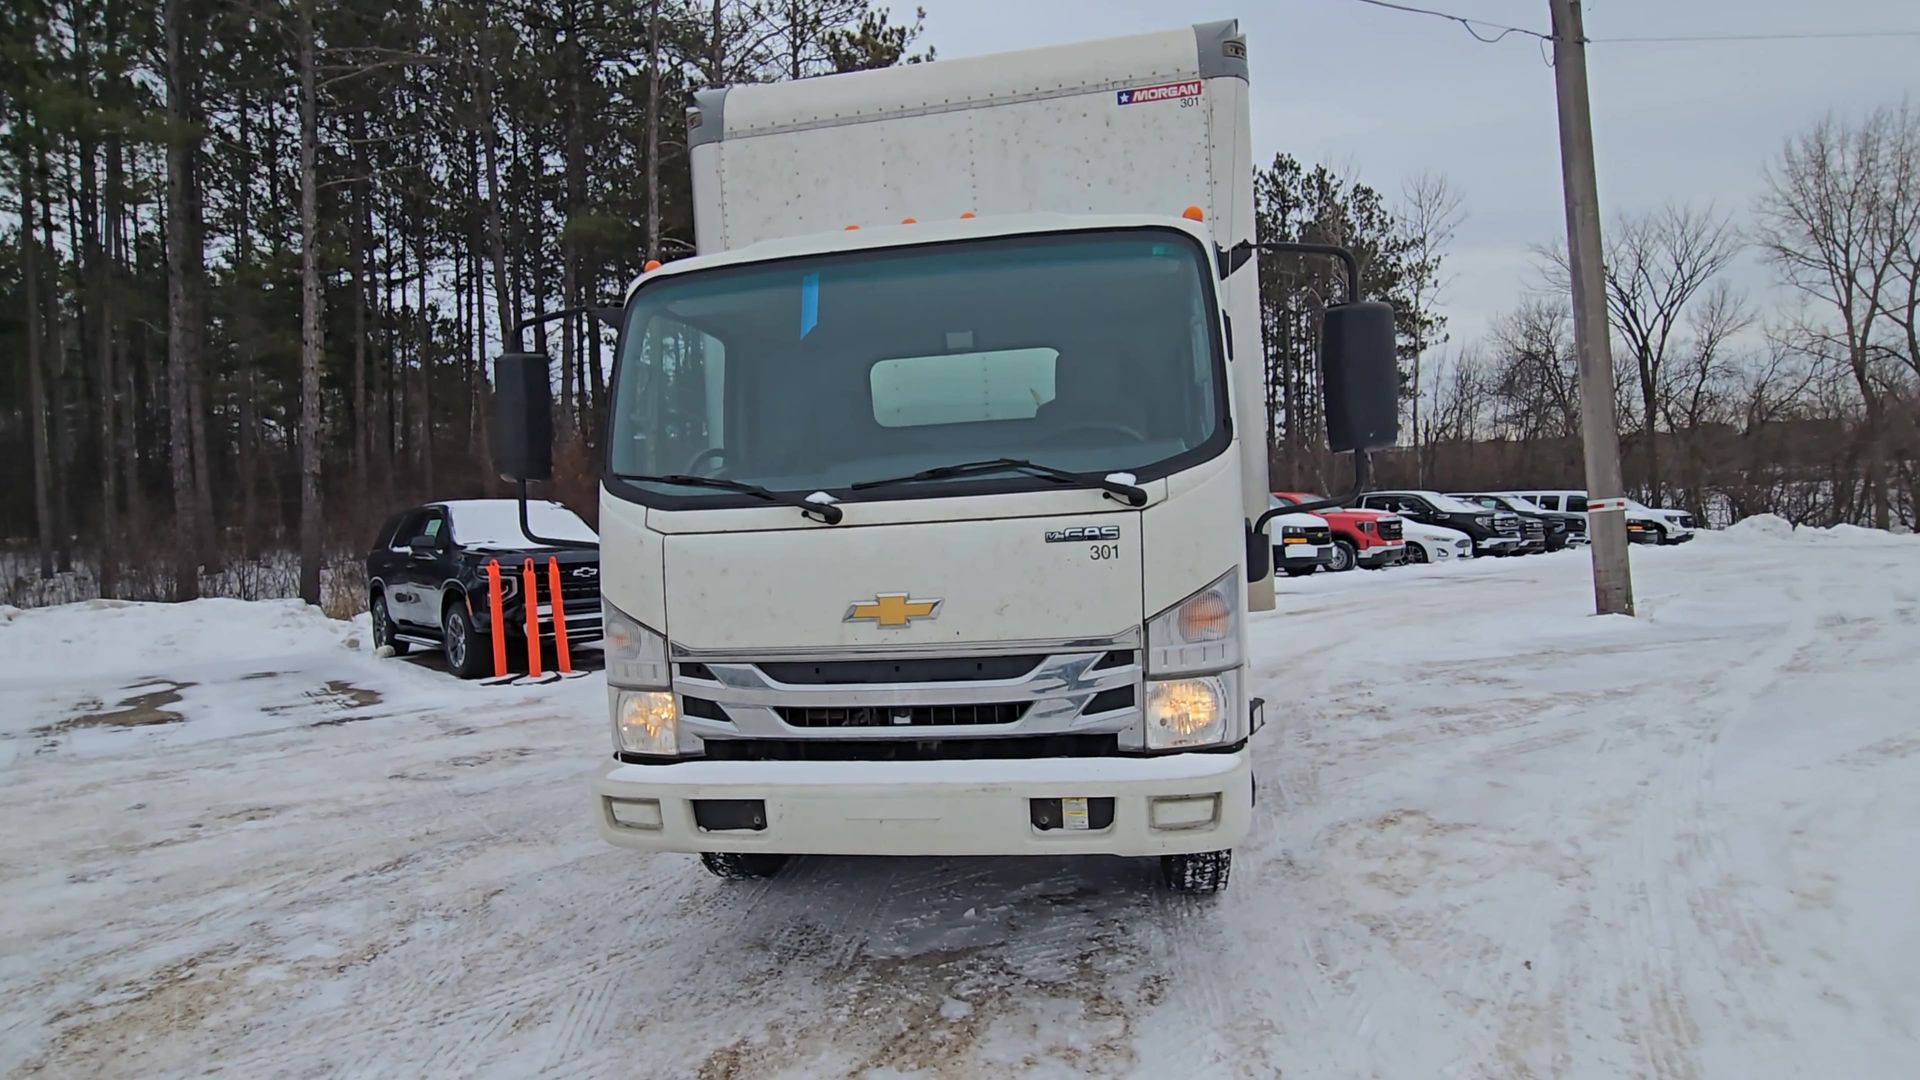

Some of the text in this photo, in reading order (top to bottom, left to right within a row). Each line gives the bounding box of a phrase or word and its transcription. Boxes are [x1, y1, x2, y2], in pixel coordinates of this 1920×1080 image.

[1132, 83, 1199, 102] MORGAN
[1180, 97, 1199, 108] 301
[1090, 544, 1119, 560] 301
